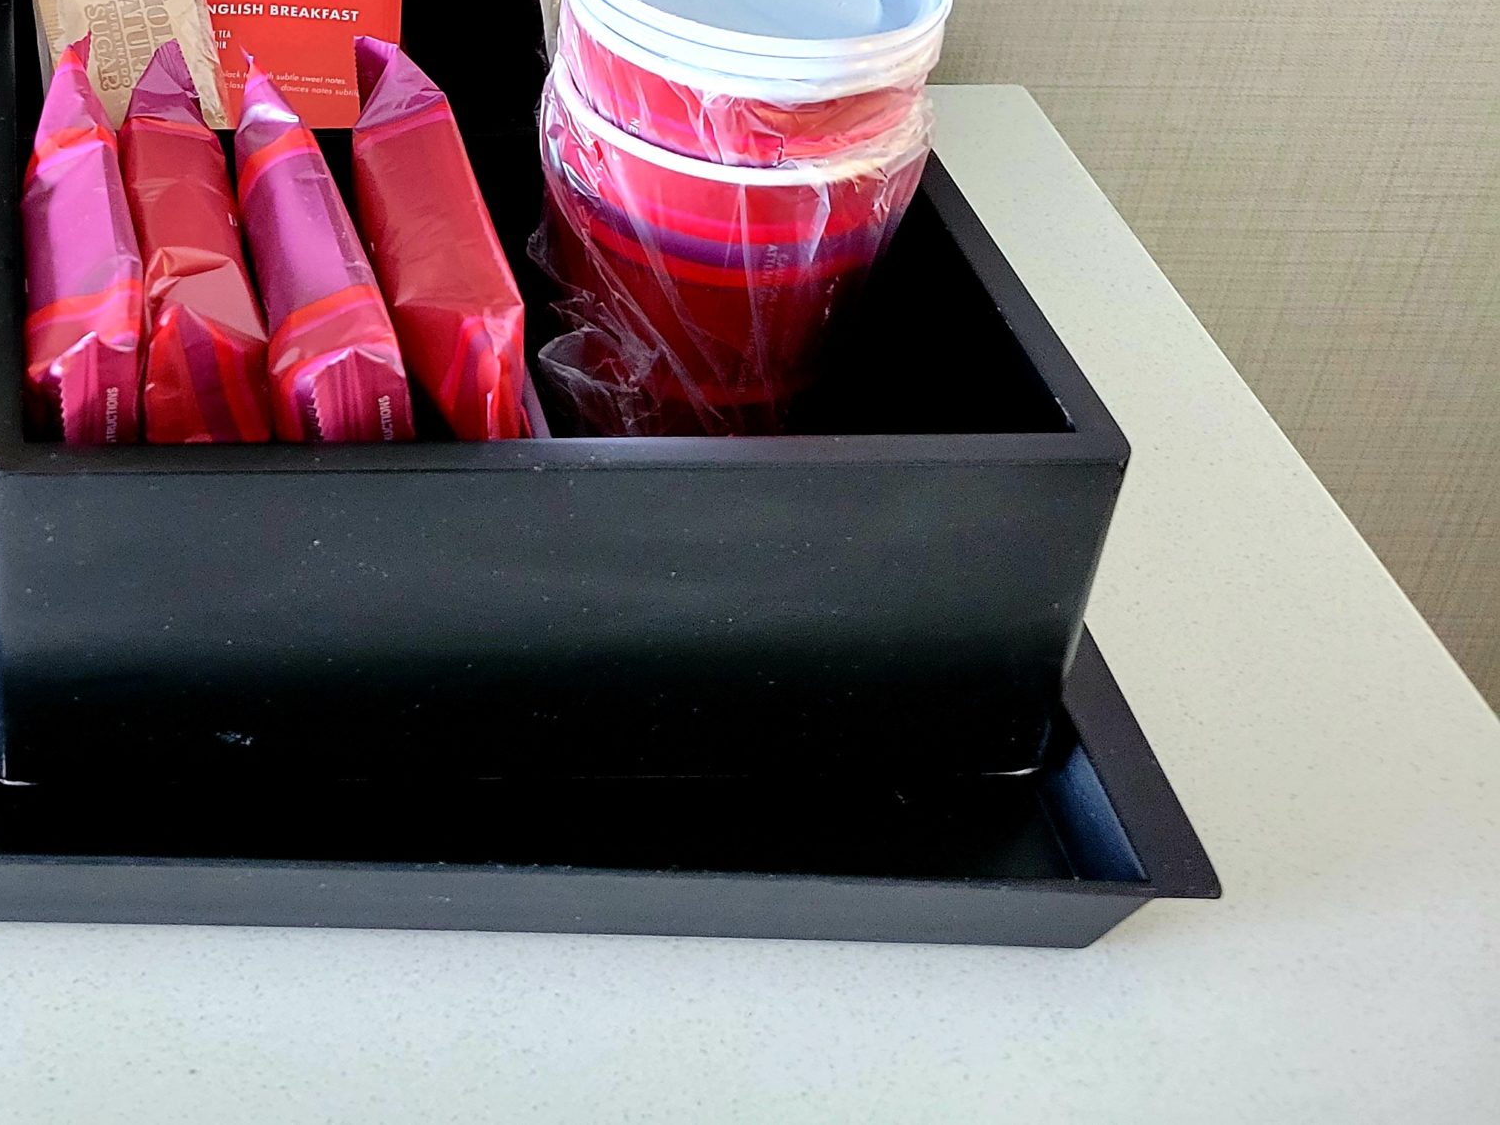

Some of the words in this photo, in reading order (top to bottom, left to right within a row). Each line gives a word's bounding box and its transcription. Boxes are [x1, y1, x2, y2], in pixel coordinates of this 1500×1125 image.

[207, 4, 263, 15] NGLISH
[270, 5, 359, 22] BREAKFAST
[85, 5, 120, 89] SUGAR
